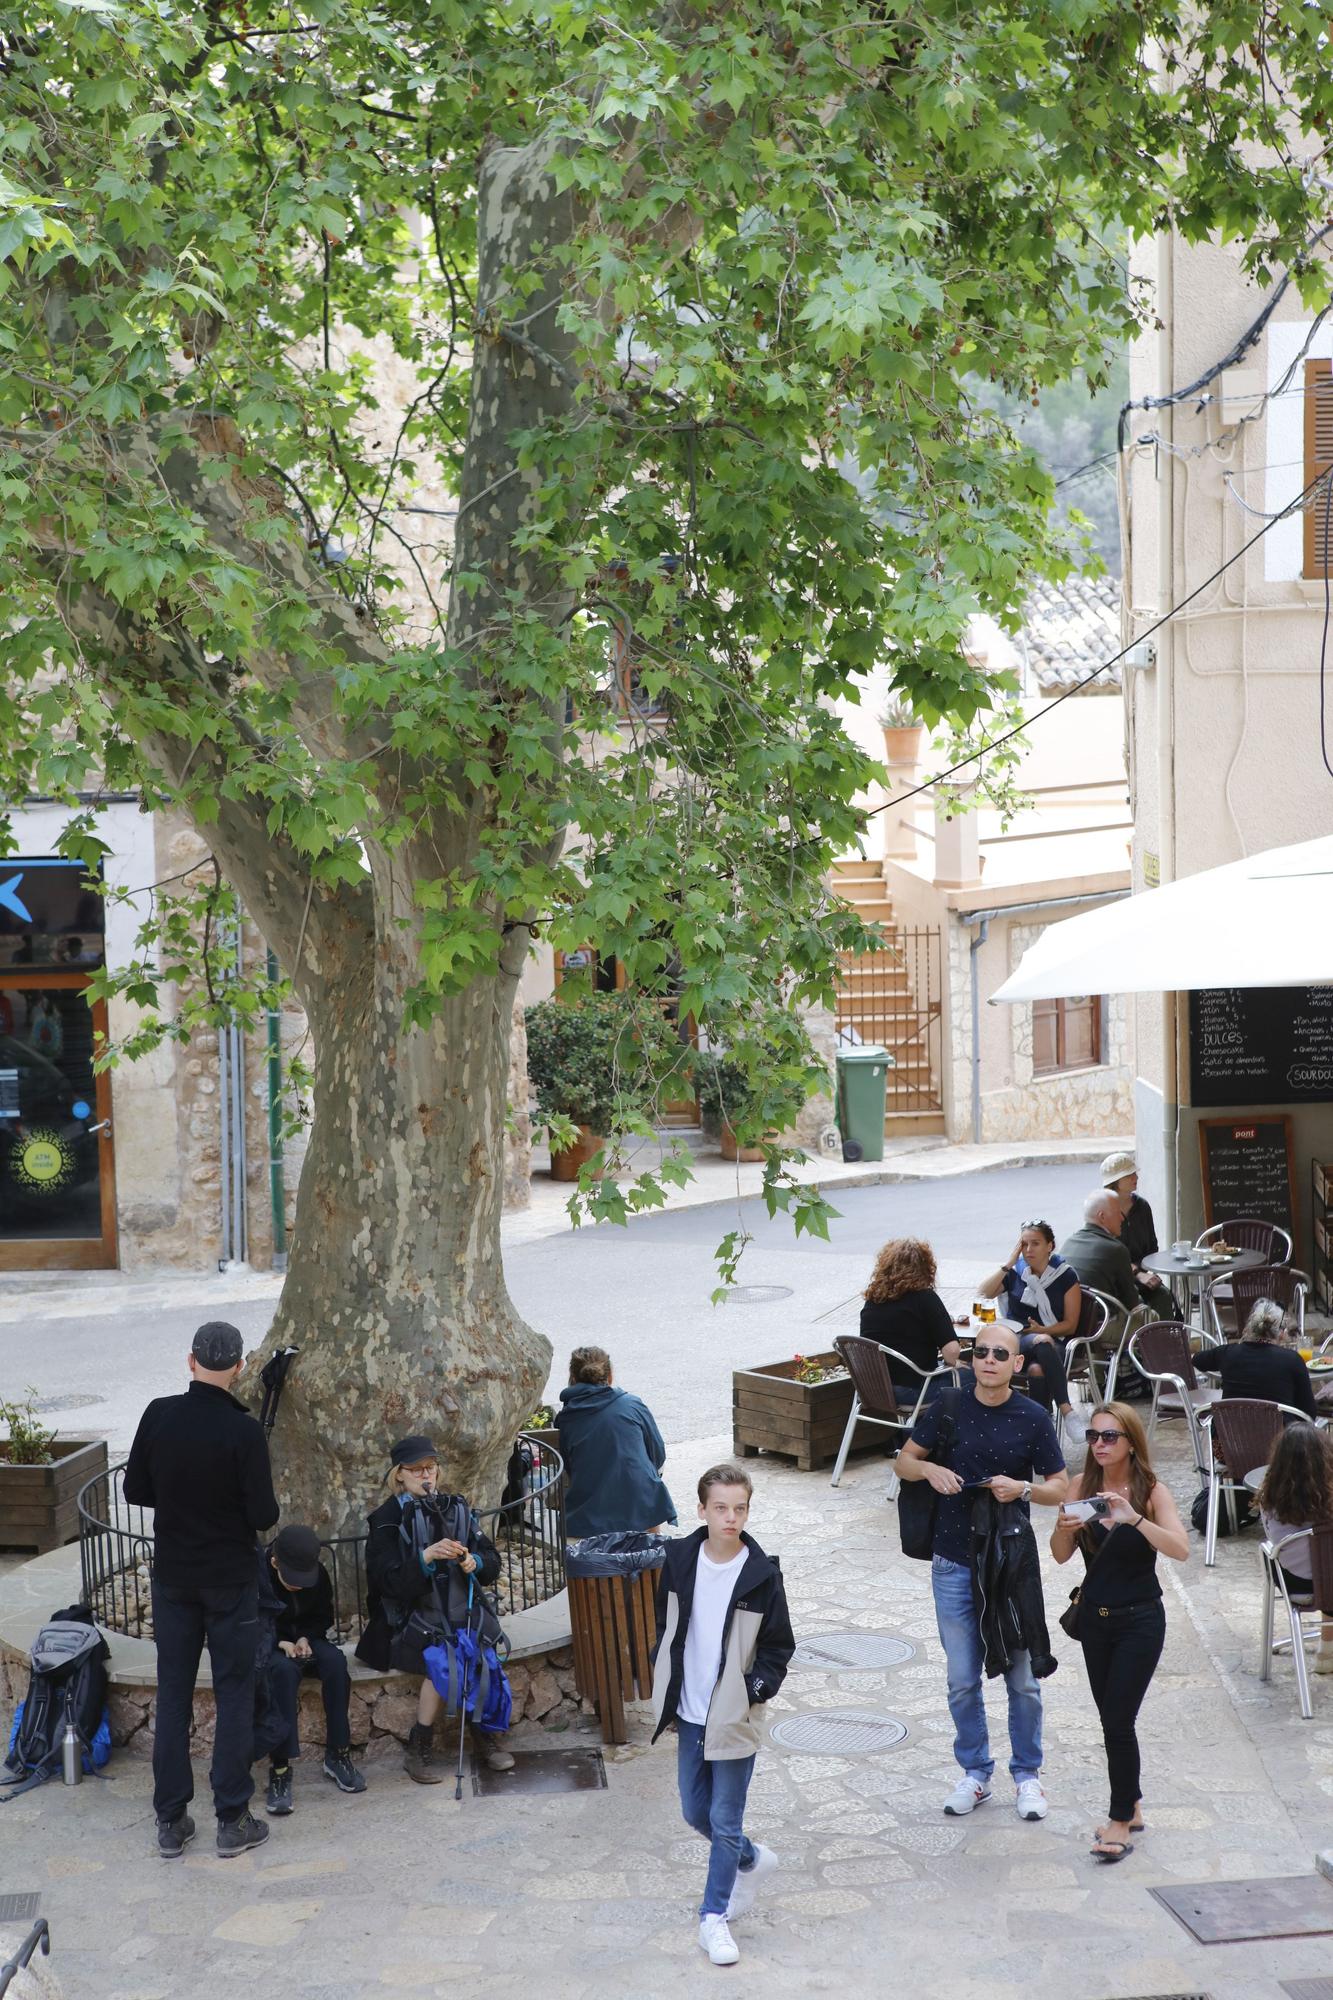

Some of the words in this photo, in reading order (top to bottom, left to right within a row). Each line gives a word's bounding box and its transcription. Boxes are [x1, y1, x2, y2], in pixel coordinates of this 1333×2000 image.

[1235, 1129, 1255, 1139] pont
[826, 1133, 836, 1149] 6
[35, 1153, 51, 1161] ATM
